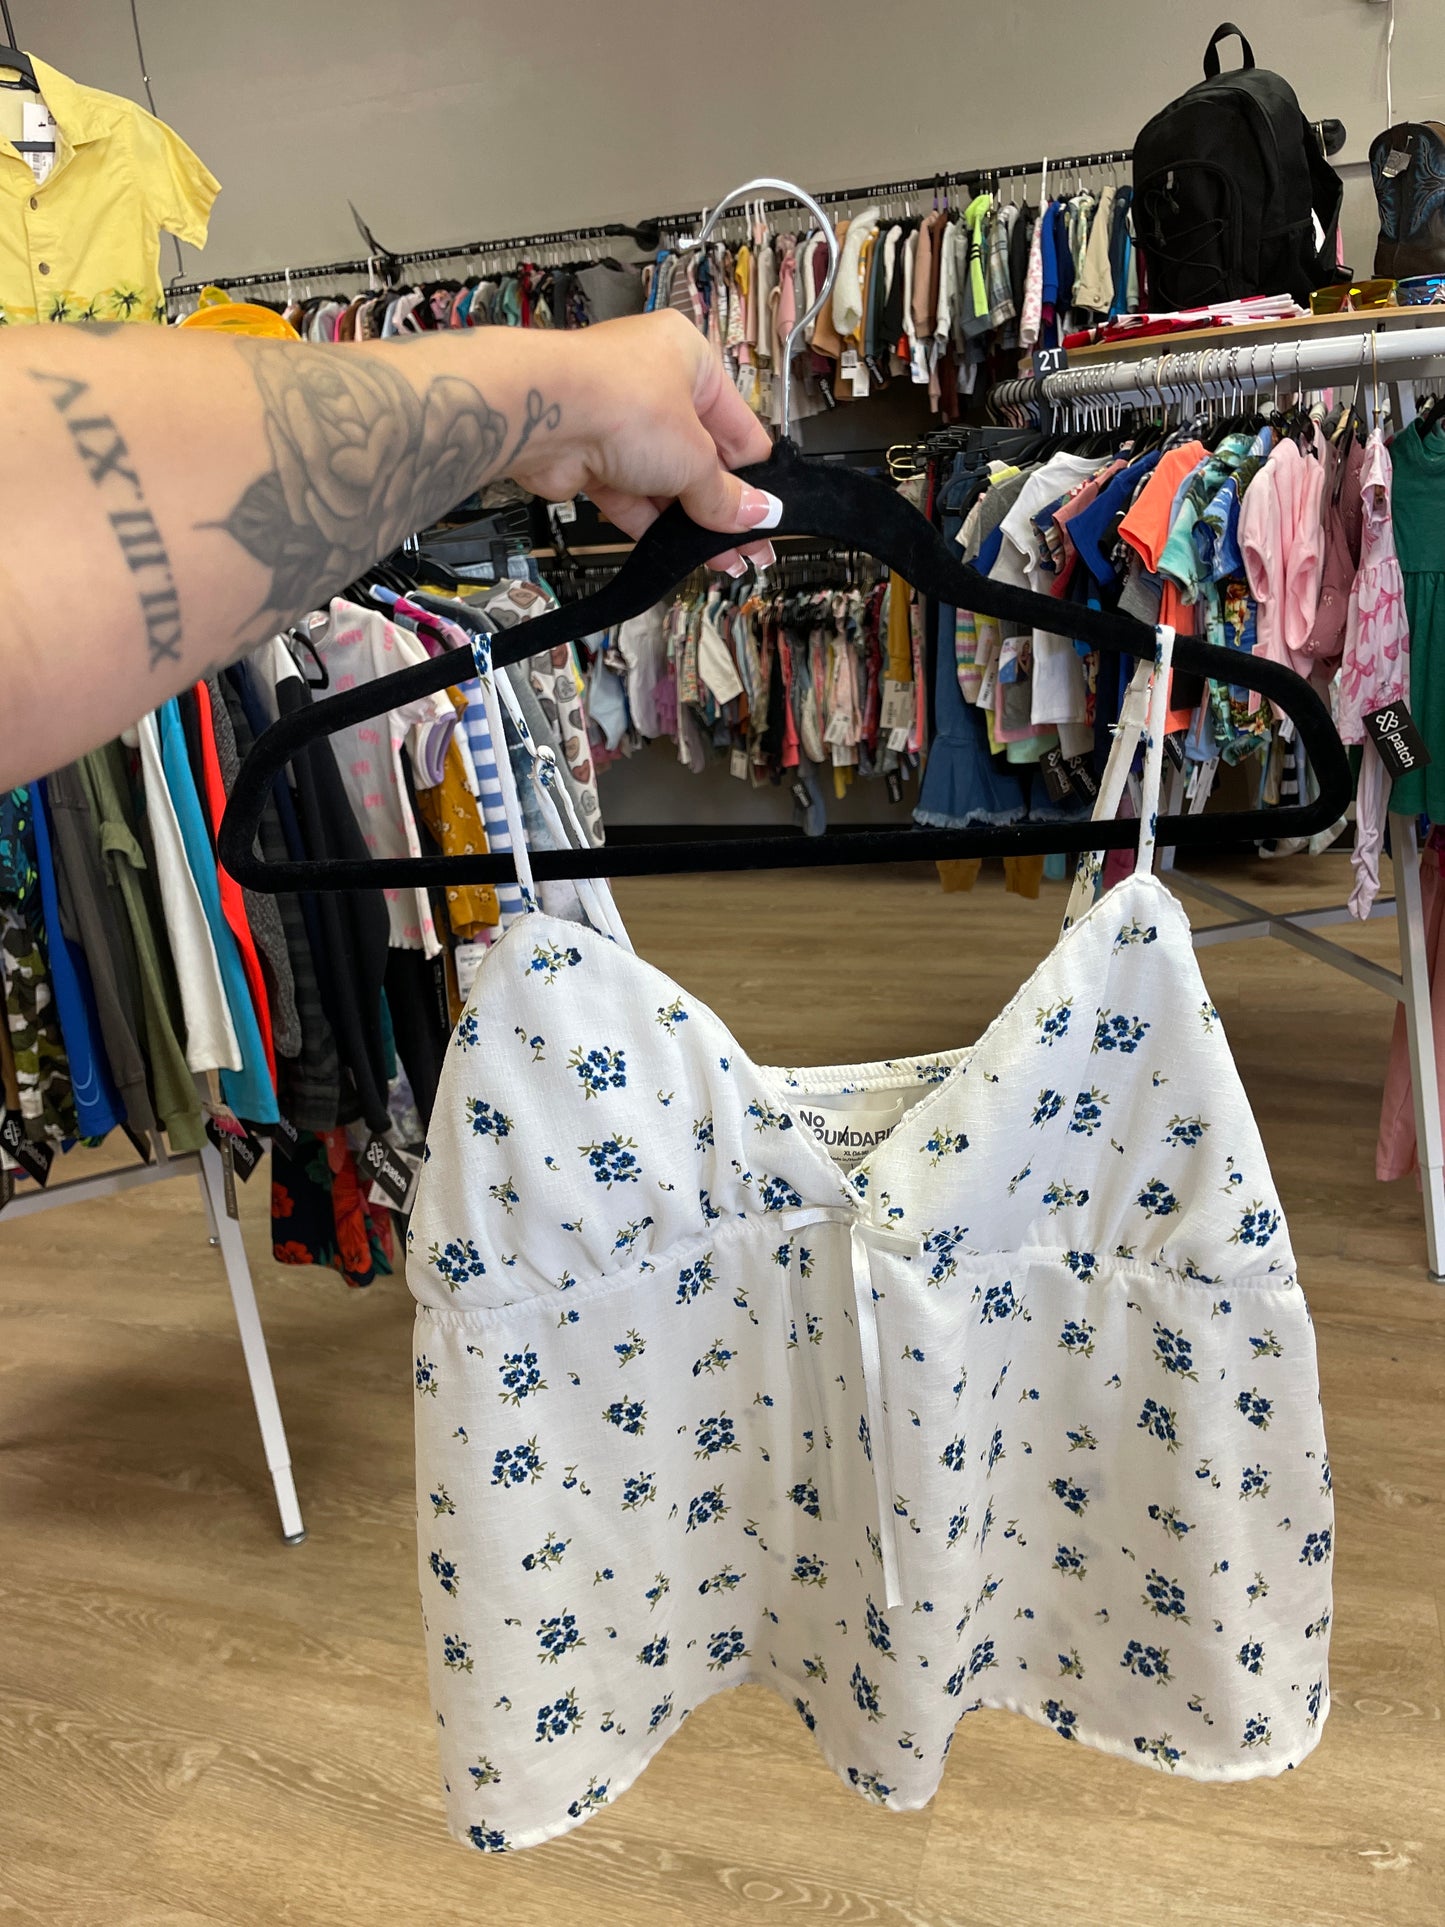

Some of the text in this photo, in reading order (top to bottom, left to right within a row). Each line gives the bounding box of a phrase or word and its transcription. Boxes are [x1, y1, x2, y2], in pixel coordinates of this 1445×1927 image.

[1038, 348, 1062, 372] 2T
[1387, 732, 1415, 768] patch
[280, 1115, 298, 1143] atch
[800, 1110, 825, 1128] NO
[382, 1160, 407, 1193] patch
